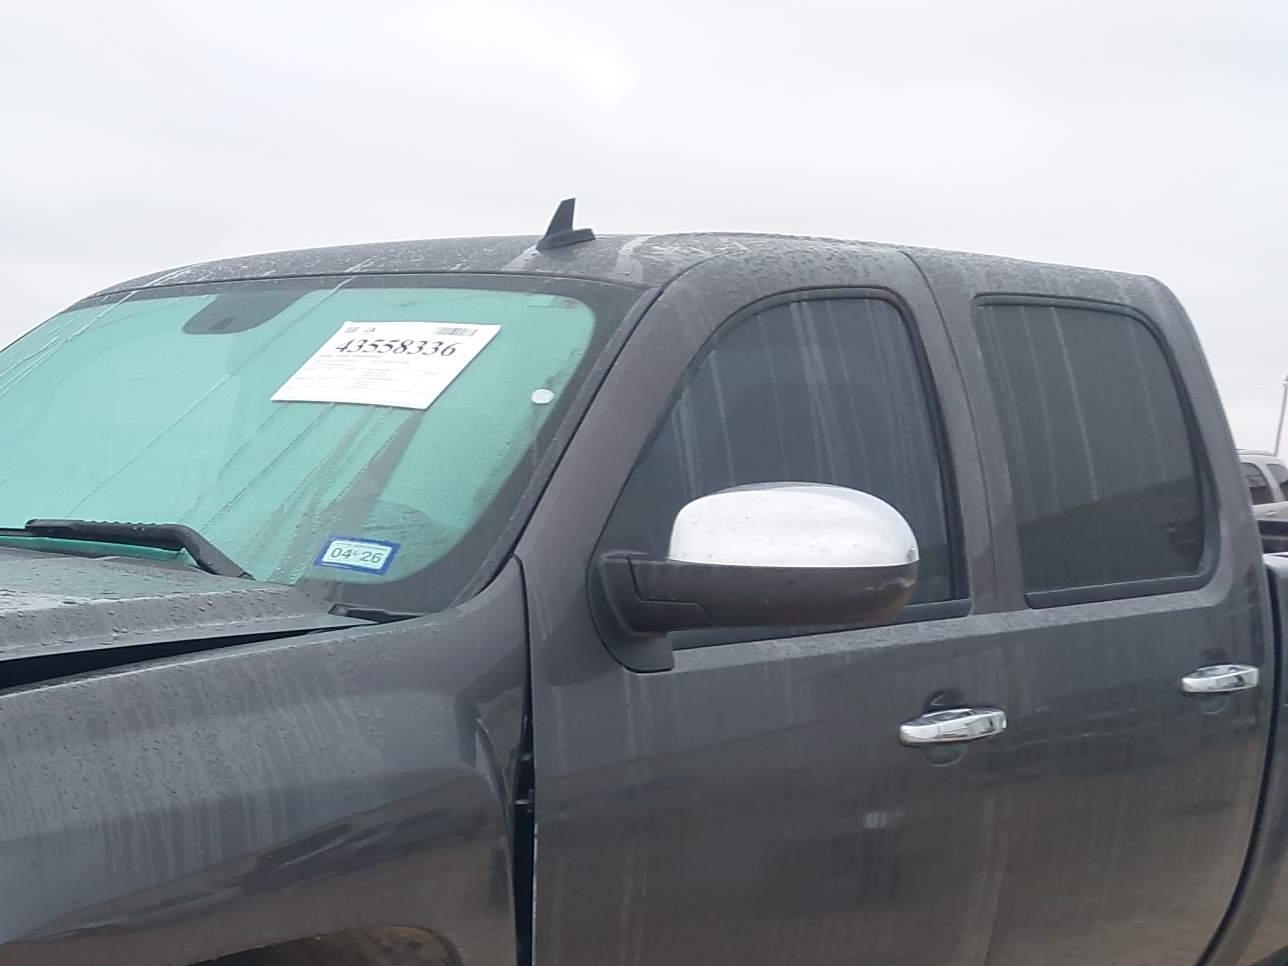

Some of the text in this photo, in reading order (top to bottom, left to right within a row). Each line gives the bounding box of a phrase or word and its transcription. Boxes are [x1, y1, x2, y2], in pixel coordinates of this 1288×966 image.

[336, 338, 461, 357] 43558336
[331, 547, 383, 563] 04 26
